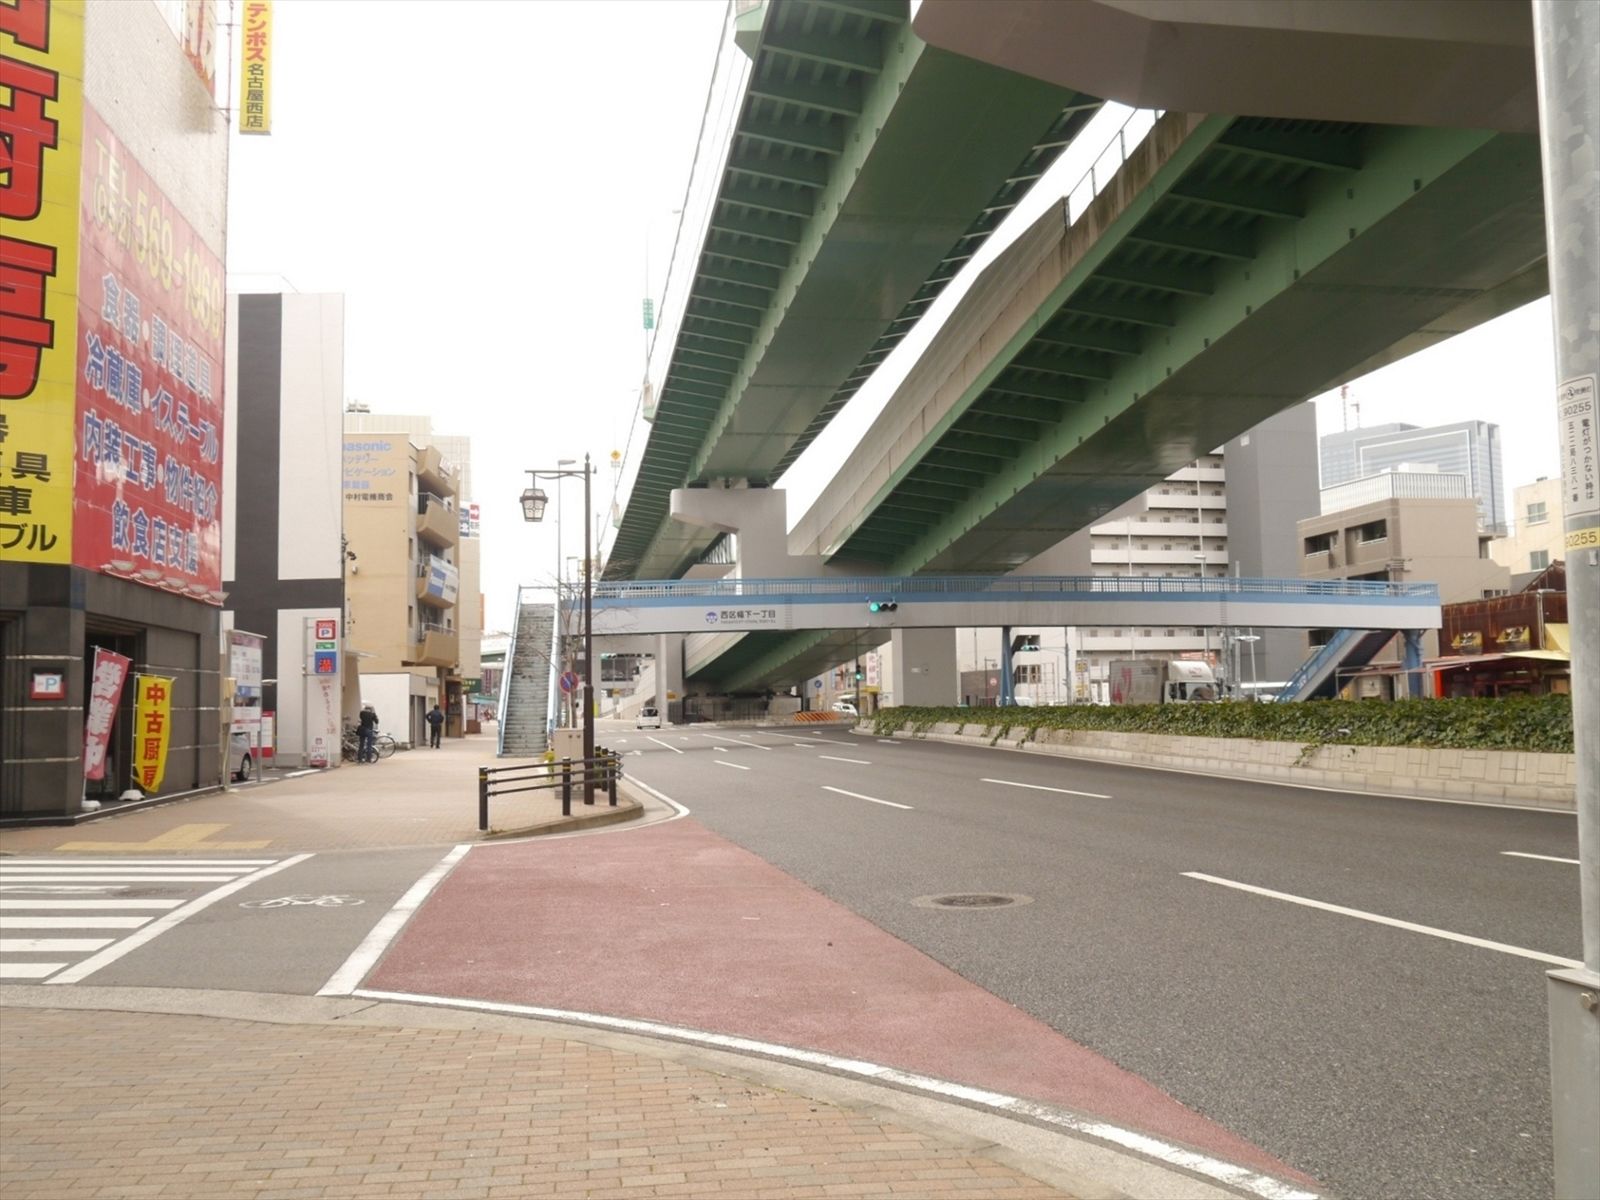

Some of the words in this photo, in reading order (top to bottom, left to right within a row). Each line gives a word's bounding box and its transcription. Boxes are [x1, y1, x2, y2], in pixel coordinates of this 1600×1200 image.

[246, 3, 267, 128] テンポス名古屋西店
[95, 138, 131, 208] TEL
[46, 677, 58, 691] P
